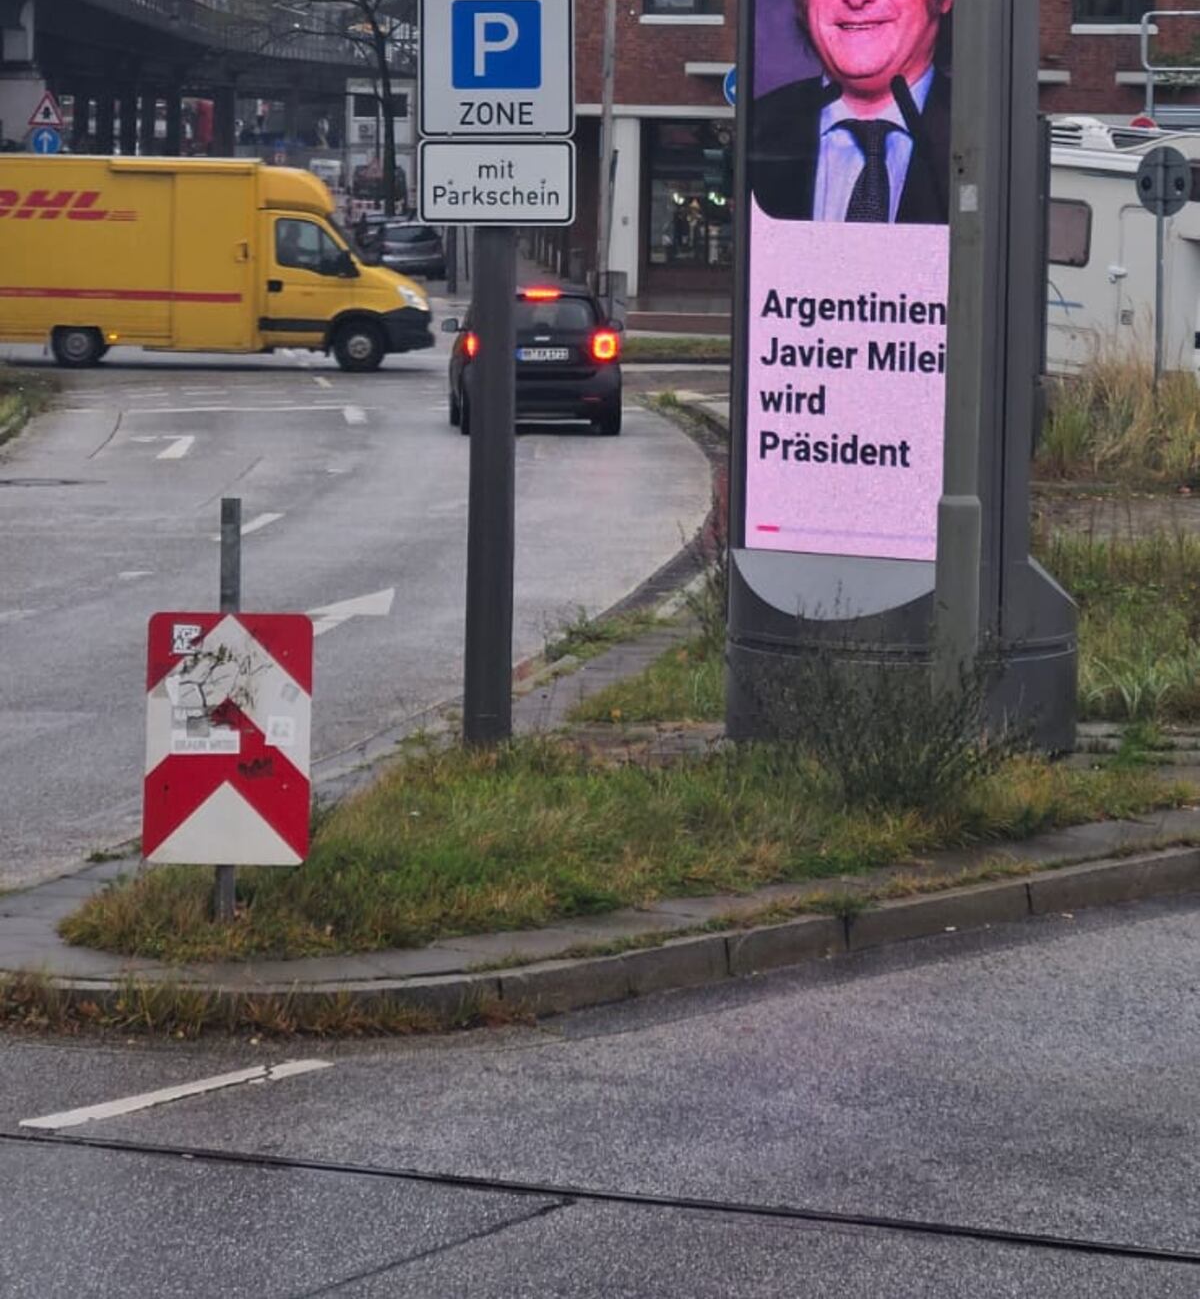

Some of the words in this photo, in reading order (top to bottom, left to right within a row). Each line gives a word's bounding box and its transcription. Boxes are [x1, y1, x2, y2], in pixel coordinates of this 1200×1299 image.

[473, 12, 519, 77] P
[459, 102, 534, 125] ZONE
[478, 160, 514, 179] mit
[433, 184, 560, 206] Parkschein
[760, 289, 946, 328] Argentinien
[760, 337, 858, 369] Javier
[868, 341, 945, 373] Milei
[760, 383, 826, 415] wird
[760, 430, 911, 468] Präsident
